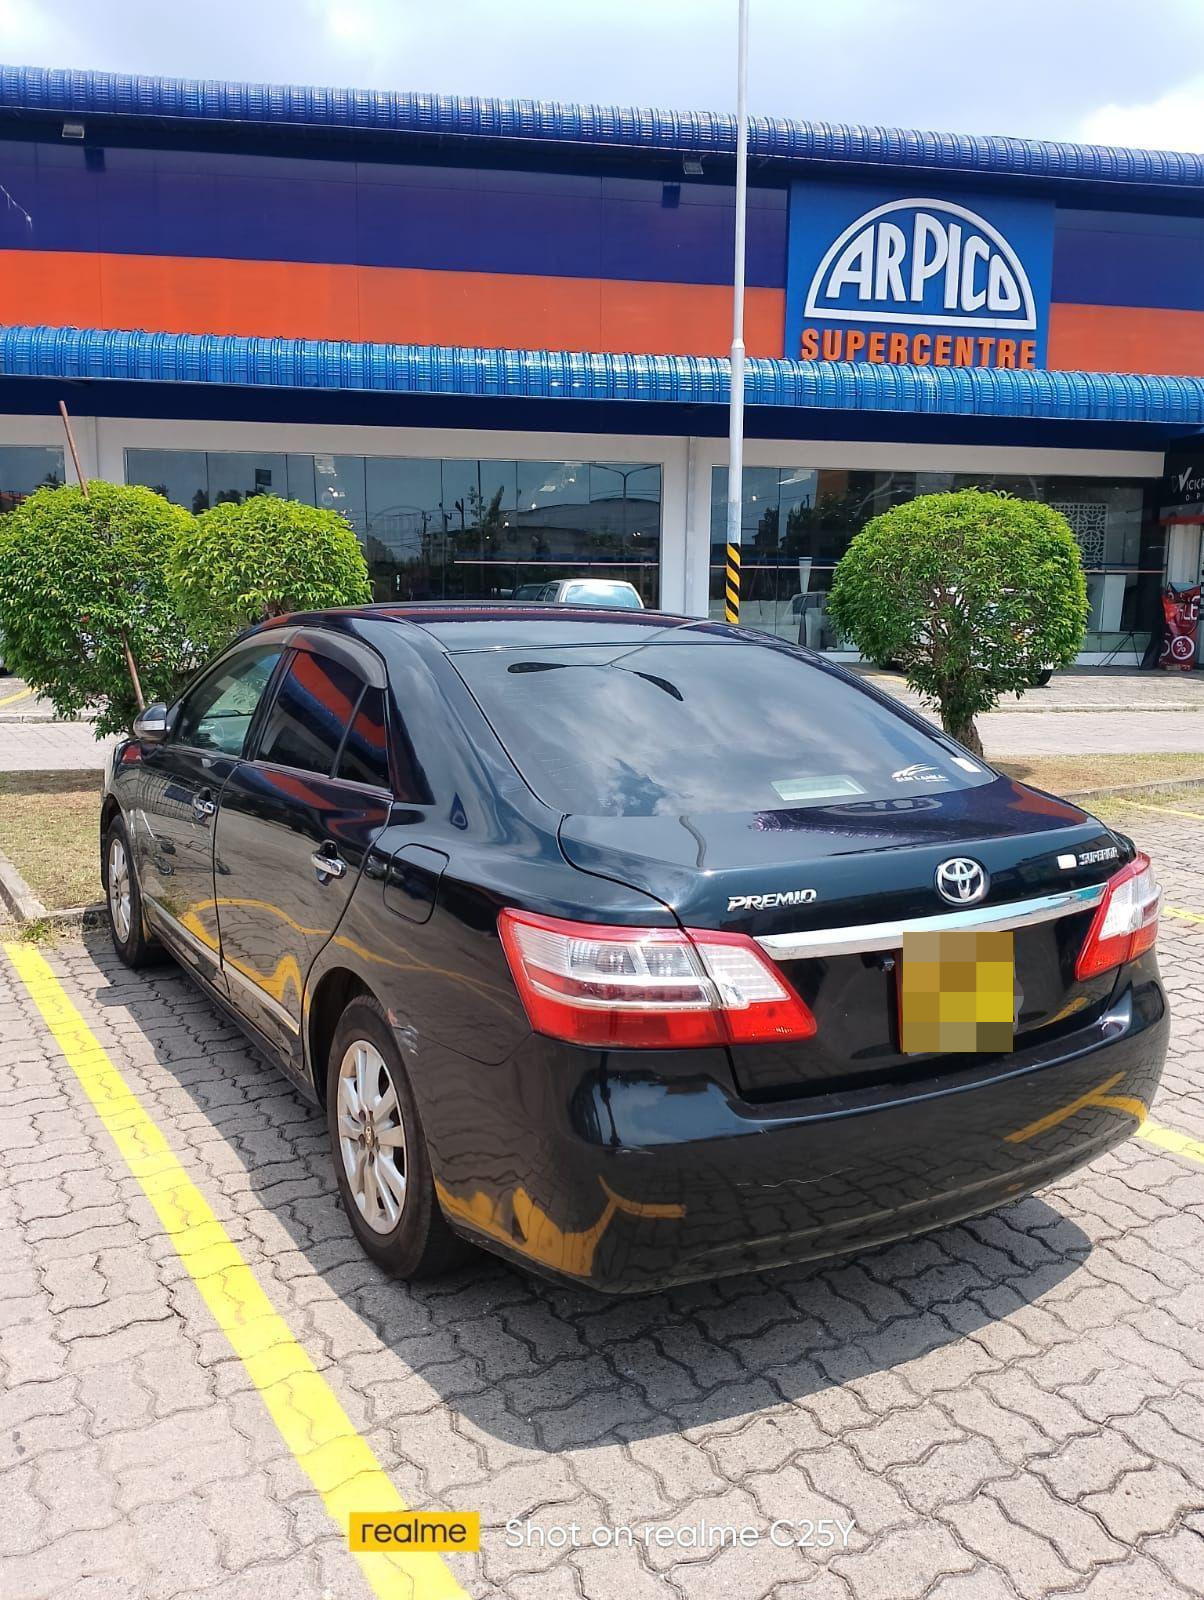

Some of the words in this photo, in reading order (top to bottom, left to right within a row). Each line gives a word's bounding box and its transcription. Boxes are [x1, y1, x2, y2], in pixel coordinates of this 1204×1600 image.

[825, 212, 1021, 312] ARPICO
[801, 327, 1037, 369] SUPERCENTRE
[727, 888, 817, 912] PREMIO
